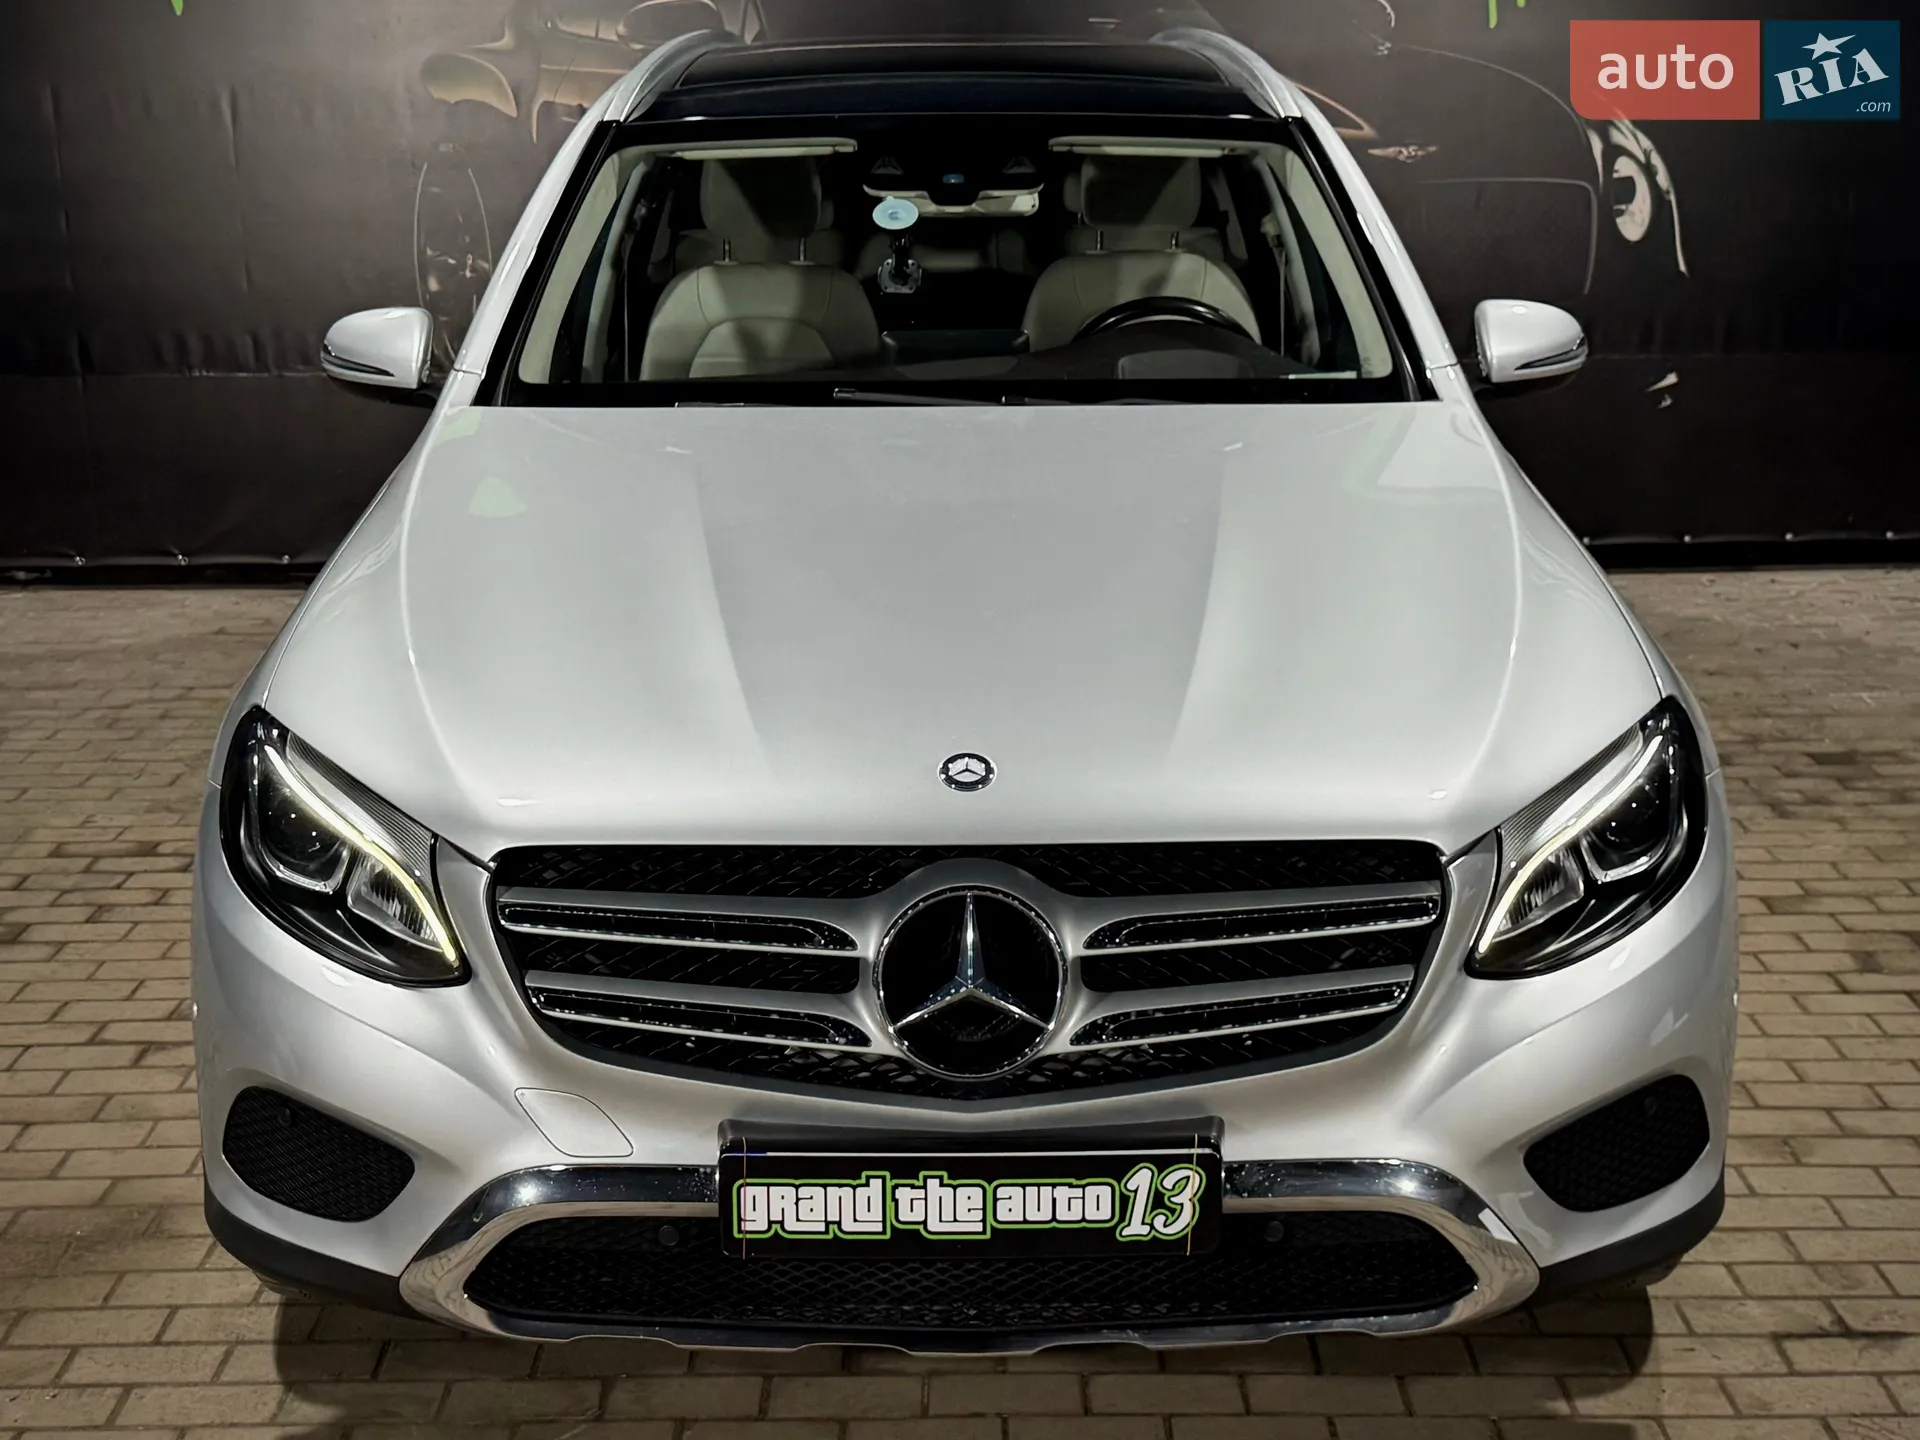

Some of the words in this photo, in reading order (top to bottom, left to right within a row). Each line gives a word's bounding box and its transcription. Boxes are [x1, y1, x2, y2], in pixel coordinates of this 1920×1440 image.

[895, 1178, 983, 1232] the
[996, 1185, 1112, 1223] auto
[1122, 1168, 1201, 1237] 13
